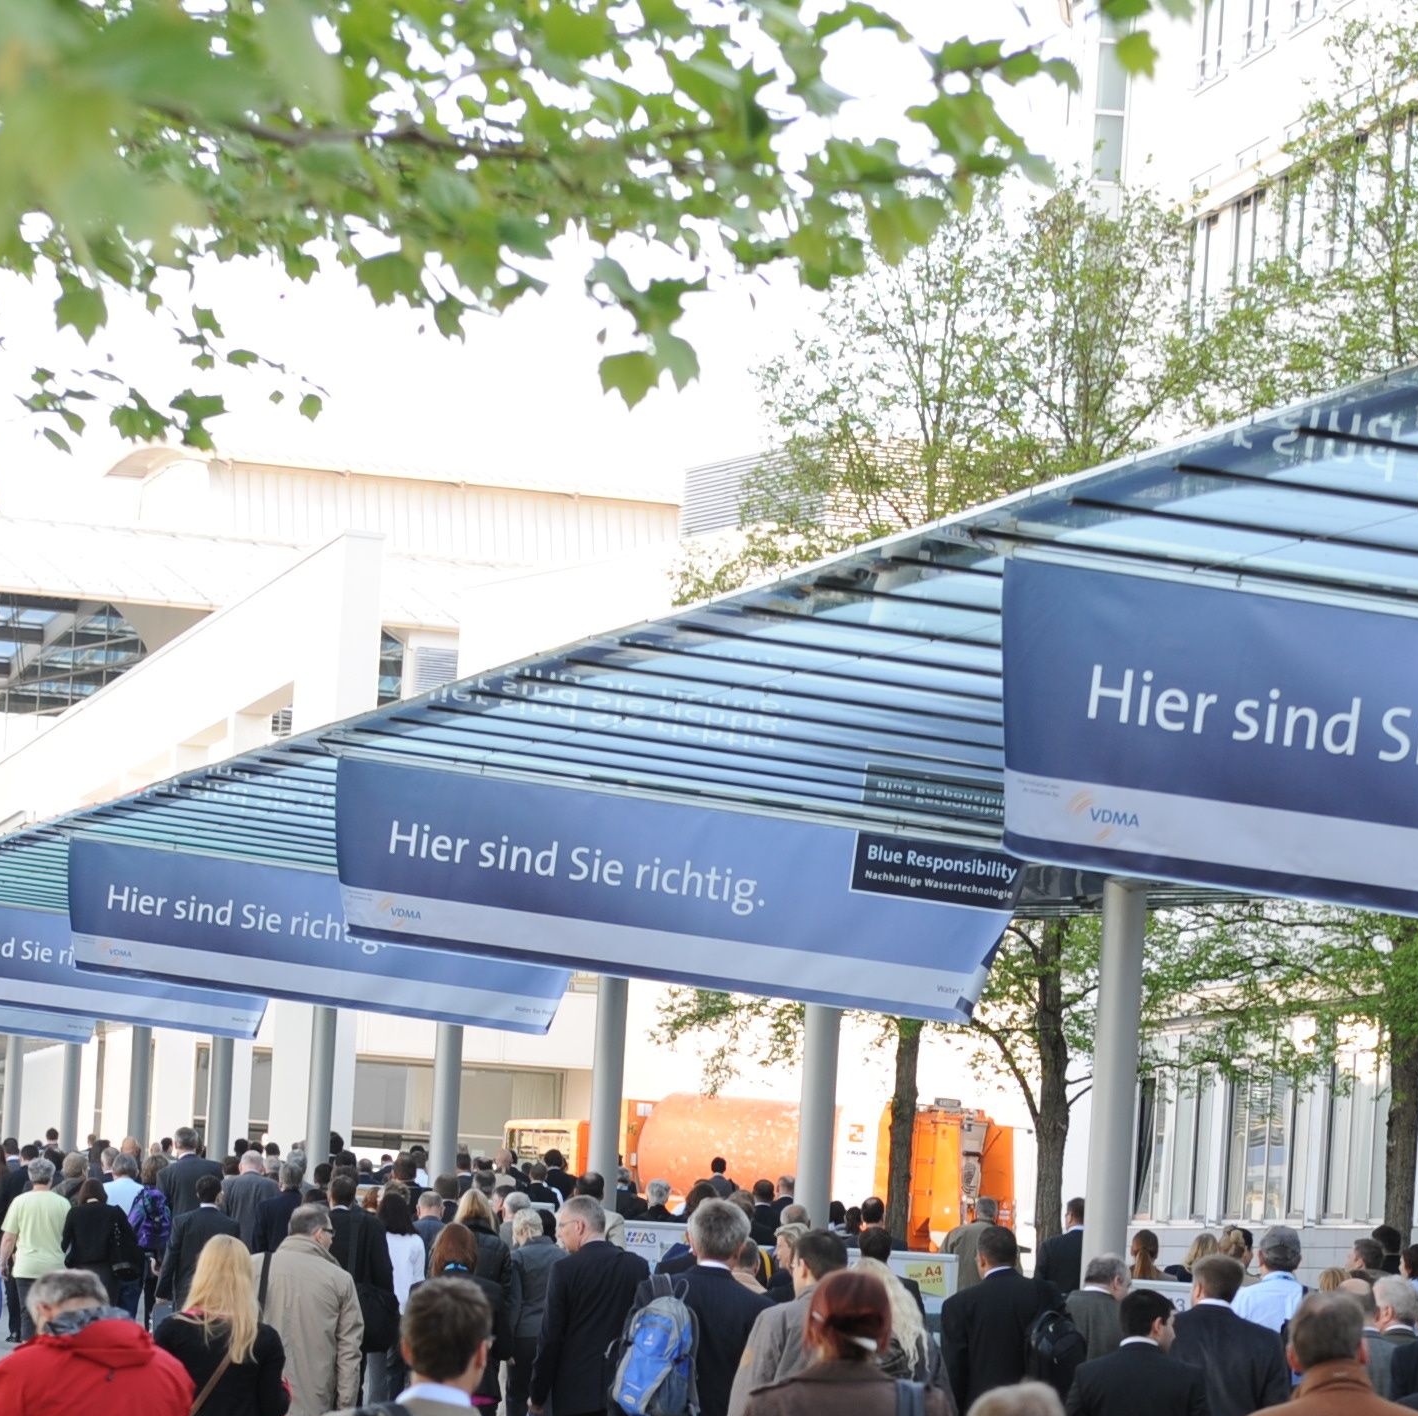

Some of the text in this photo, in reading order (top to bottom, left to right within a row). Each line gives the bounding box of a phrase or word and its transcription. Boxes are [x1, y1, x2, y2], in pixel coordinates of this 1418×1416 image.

[1087, 664, 1218, 734] Hier
[1232, 688, 1361, 756] sind
[1090, 807, 1140, 828] VDMA
[388, 820, 765, 916] Hier sind Sie richtig.
[867, 844, 1018, 884] Blue Responsibility
[864, 869, 1014, 900] Nachhaltige Wassertechnologie
[107, 884, 167, 915] Hier
[173, 894, 233, 927] sind
[241, 904, 282, 933] Sie
[391, 907, 421, 920] VDMA
[21, 940, 52, 963] Sie
[925, 1265, 942, 1277] A4
